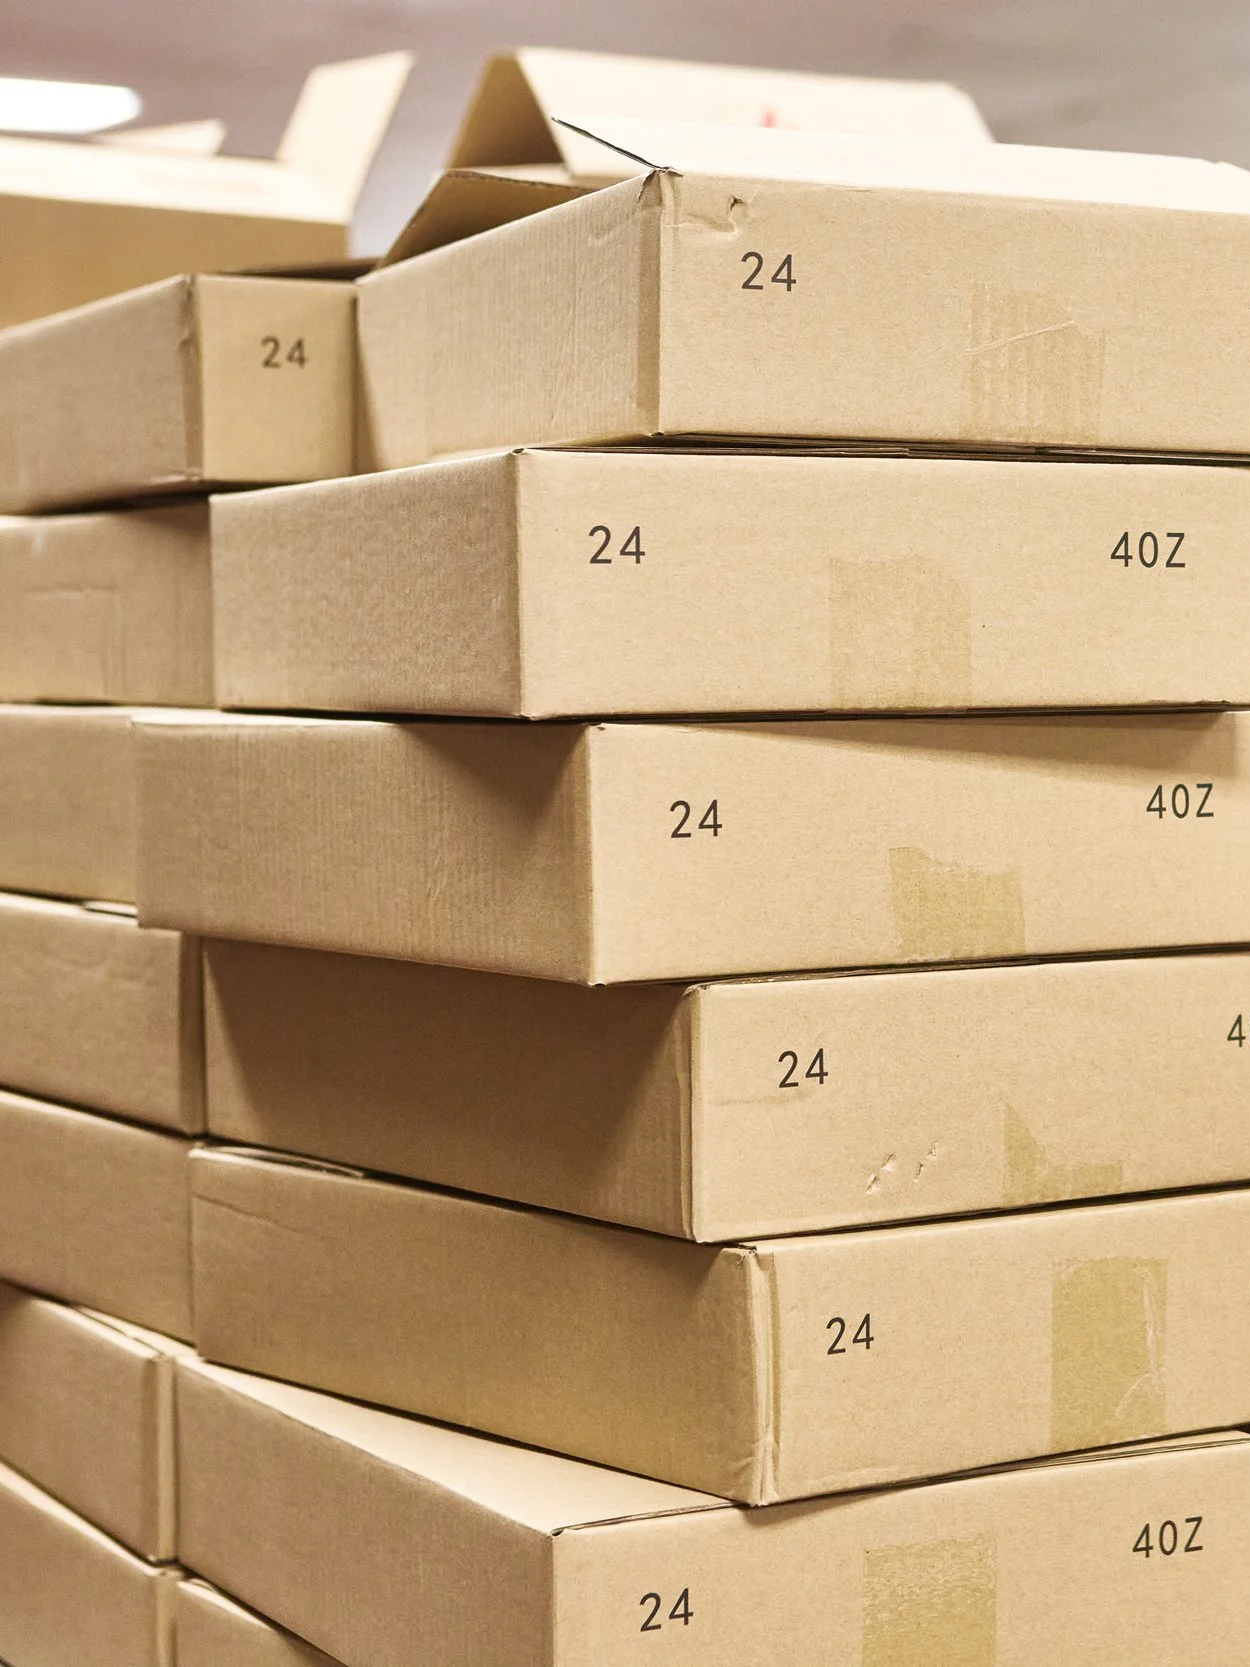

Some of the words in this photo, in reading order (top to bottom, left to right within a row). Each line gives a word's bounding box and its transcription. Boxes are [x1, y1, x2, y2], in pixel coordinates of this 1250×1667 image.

[741, 251, 796, 291] 24
[261, 336, 309, 369] 24
[588, 525, 645, 564] 24
[669, 799, 722, 838] 24
[778, 1047, 828, 1088] 24
[826, 1313, 874, 1355] 24
[639, 1587, 693, 1632] 24
